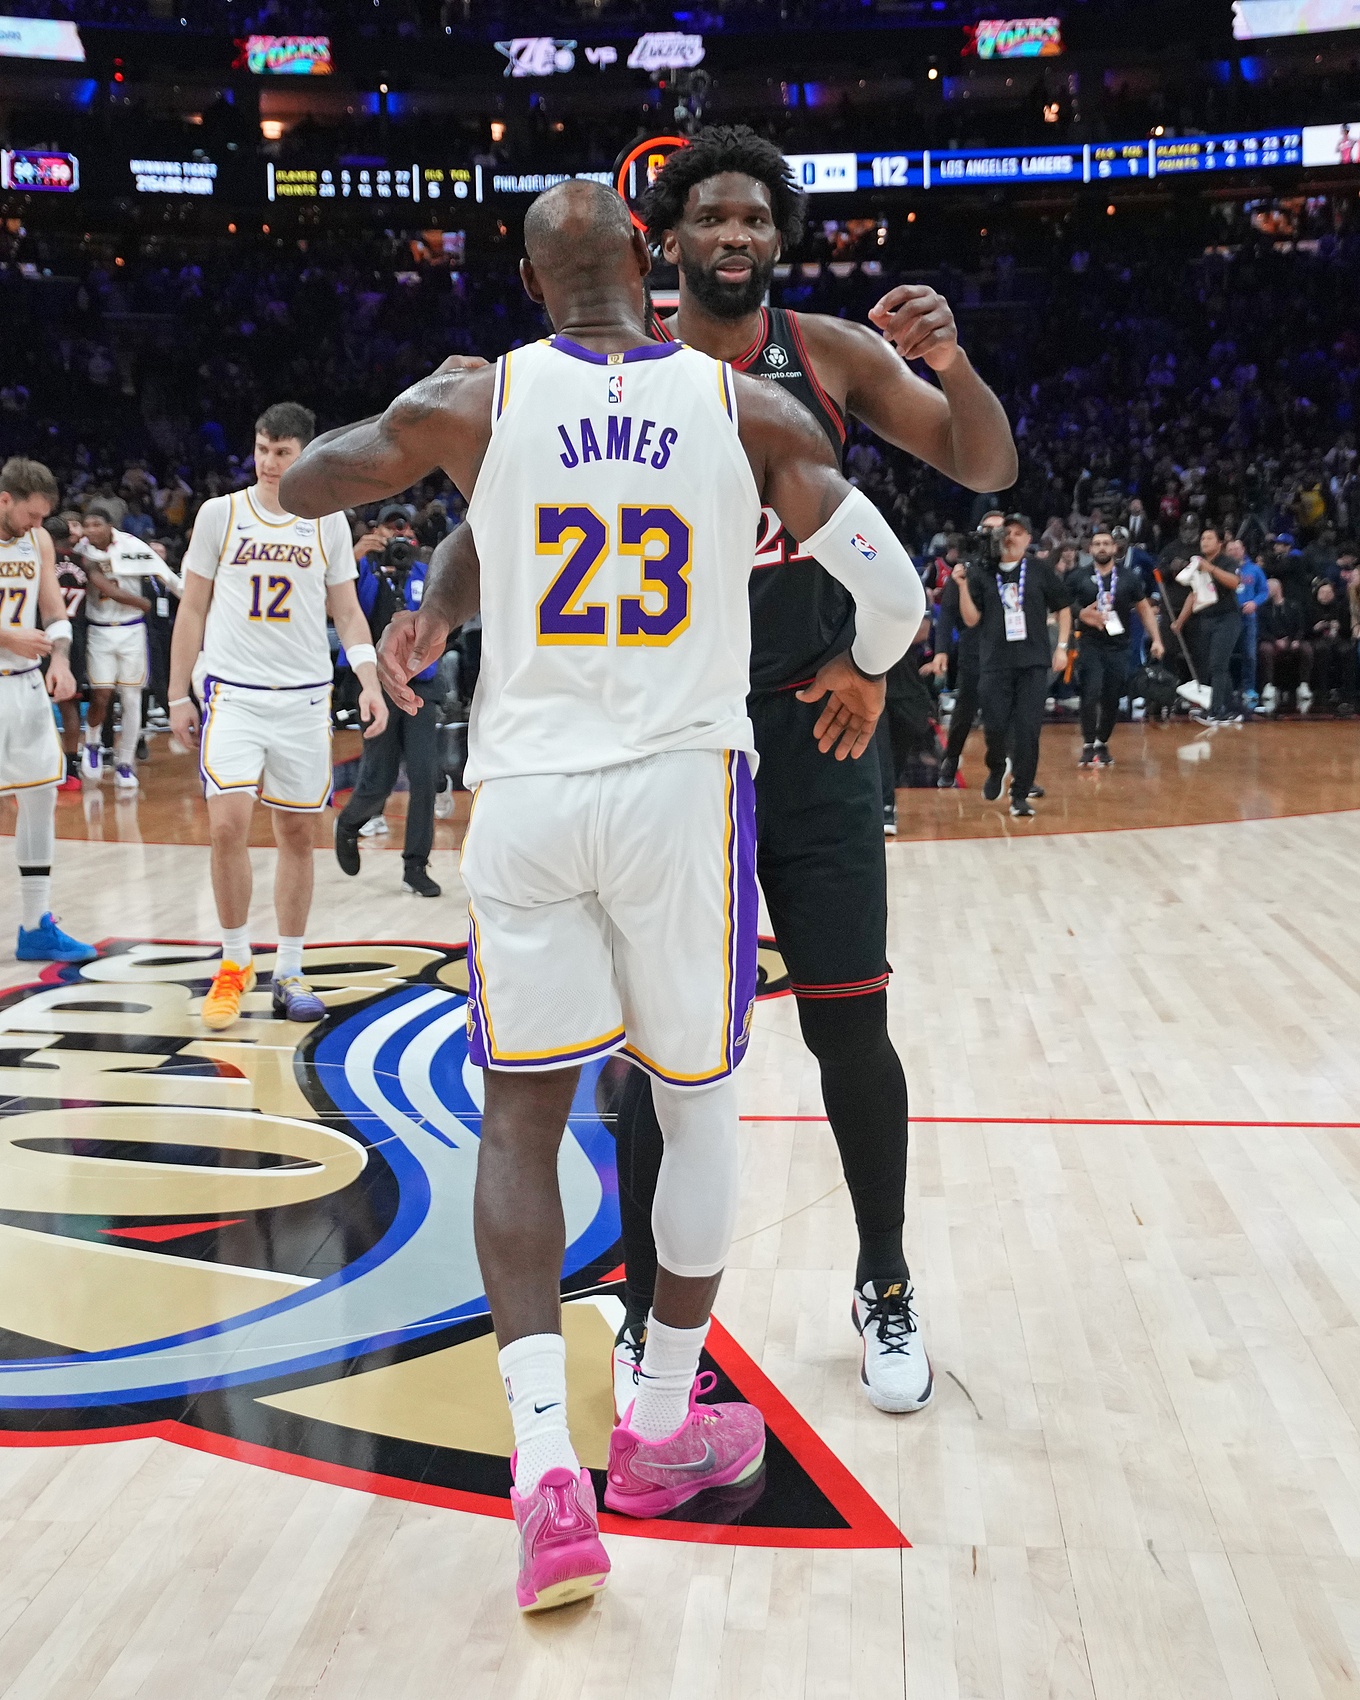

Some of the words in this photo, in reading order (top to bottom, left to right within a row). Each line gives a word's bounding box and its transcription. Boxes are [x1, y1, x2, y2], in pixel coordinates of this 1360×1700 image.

[1156, 142, 1201, 157] PLAYER
[1204, 140, 1216, 155] 7
[1222, 139, 1239, 154] 12
[1261, 135, 1280, 151] 23
[871, 156, 909, 187] 112
[940, 159, 964, 179] LOS
[965, 157, 1018, 178] ANGELES
[1021, 155, 1074, 176] LAKERS
[1097, 160, 1112, 178] 5
[1127, 158, 1139, 176] 1
[1157, 156, 1200, 171] POINTS
[427, 181, 441, 199] 5
[453, 181, 469, 199] 0
[558, 415, 679, 470] JAMES
[120, 552, 154, 561] PURE
[229, 536, 314, 569] LAKERS
[534, 503, 694, 648] 23
[60, 586, 87, 618] 7
[248, 574, 293, 623] 12
[883, 1282, 902, 1299] JE
